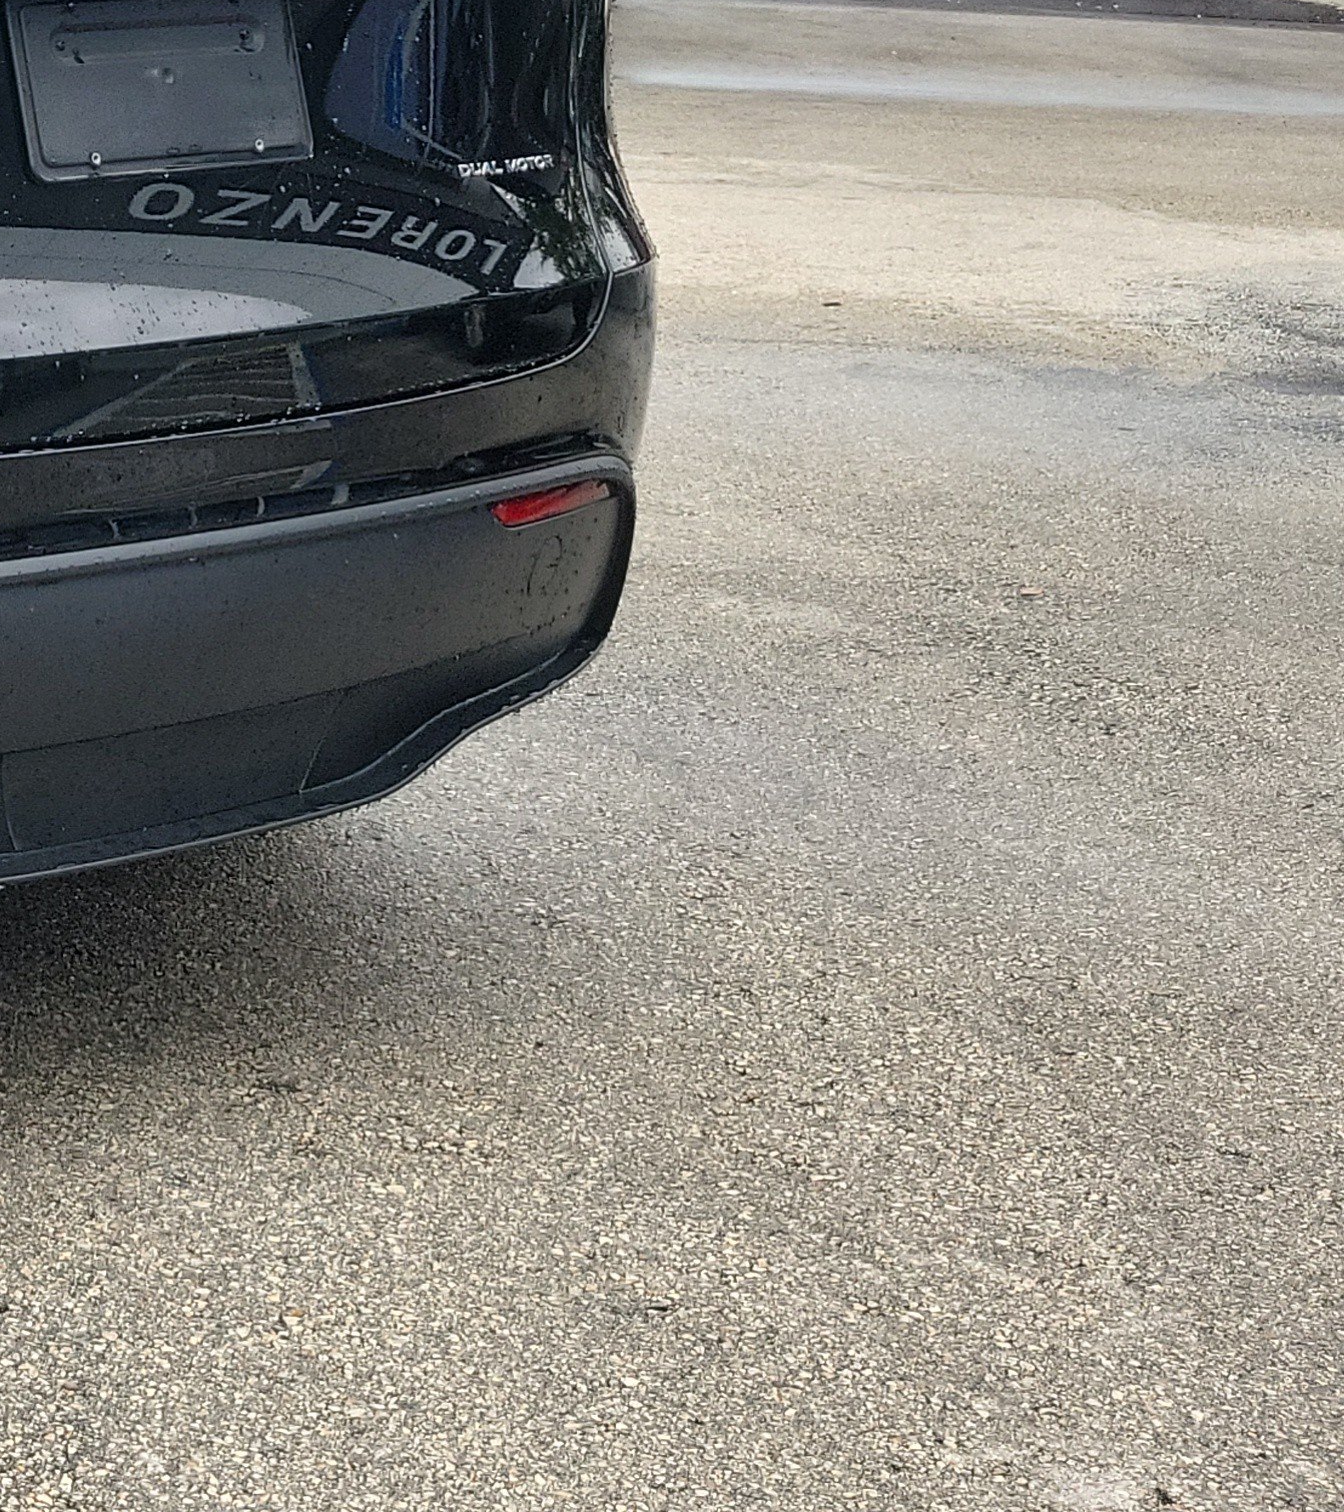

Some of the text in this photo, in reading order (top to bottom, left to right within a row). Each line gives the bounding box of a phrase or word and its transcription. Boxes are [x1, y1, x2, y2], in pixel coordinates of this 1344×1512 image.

[457, 153, 554, 178] DUAL MOTOR
[128, 182, 508, 276] LORENZO
